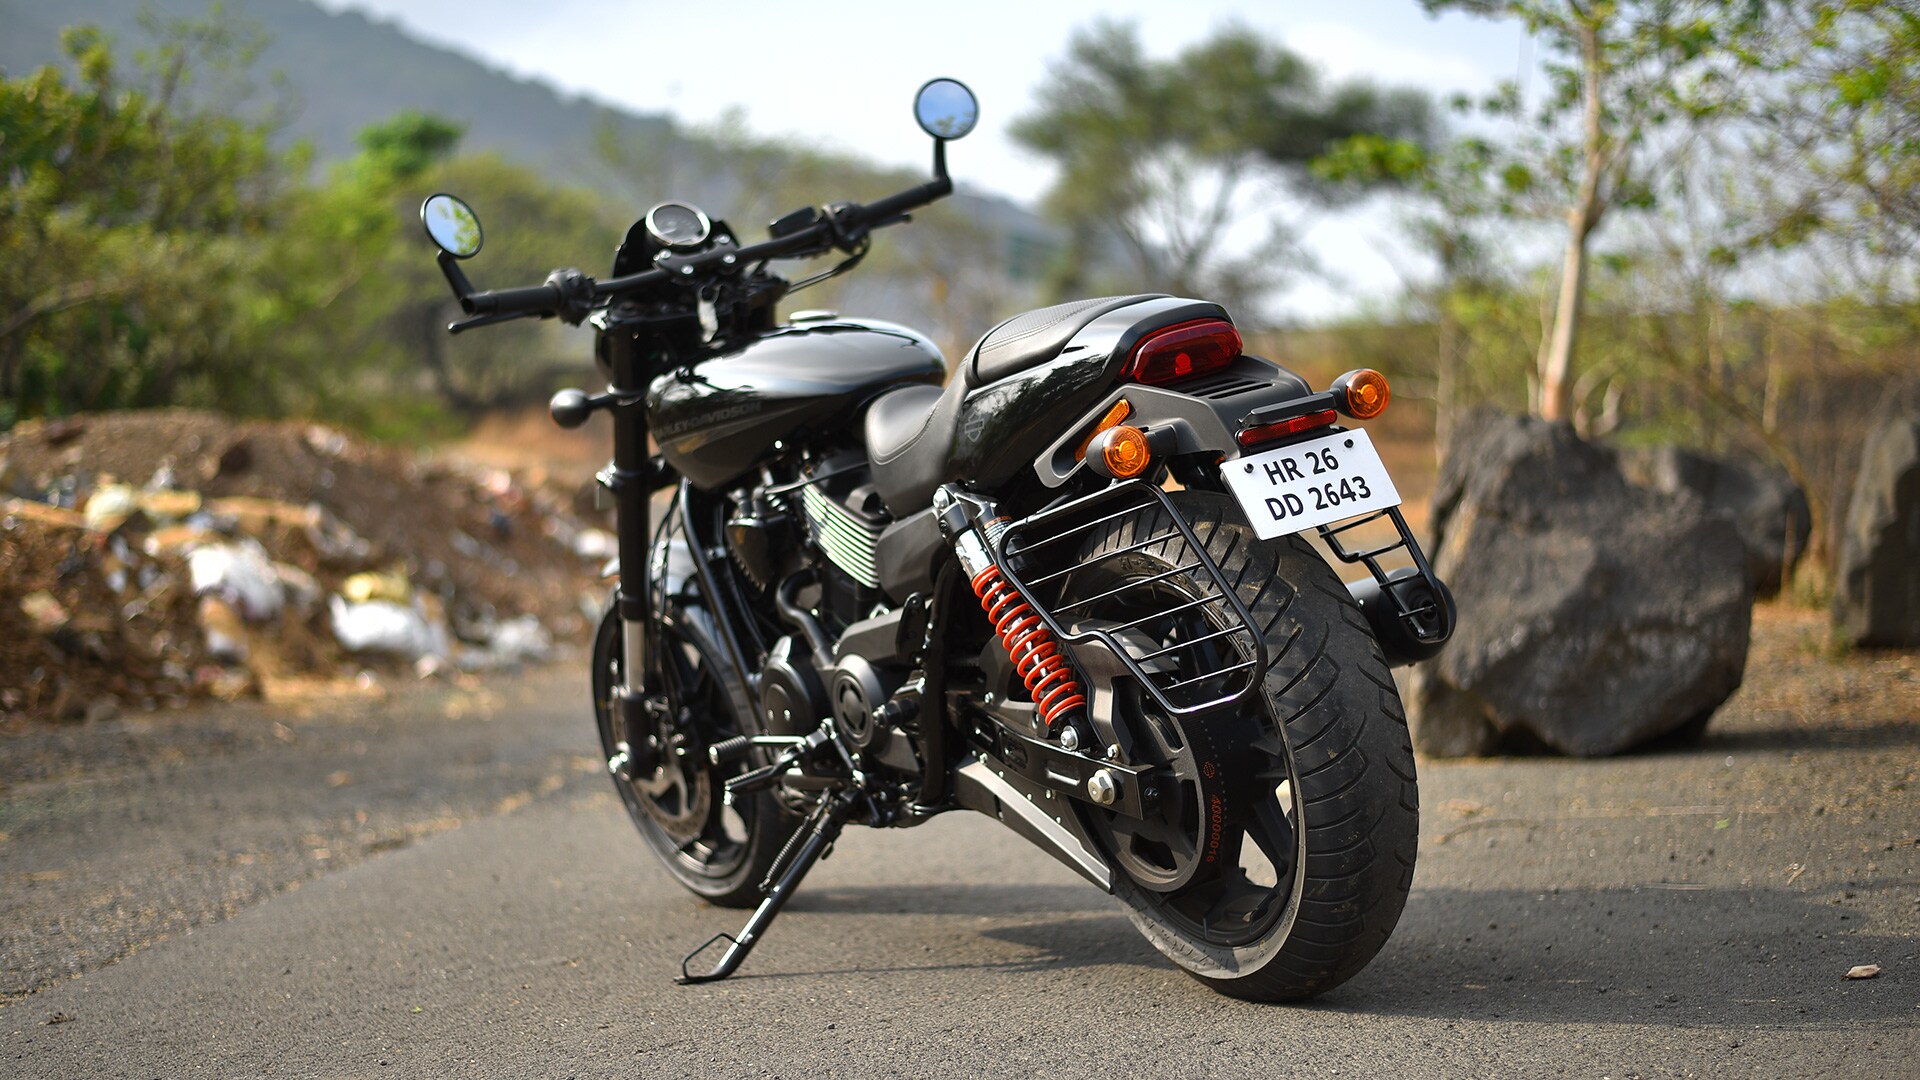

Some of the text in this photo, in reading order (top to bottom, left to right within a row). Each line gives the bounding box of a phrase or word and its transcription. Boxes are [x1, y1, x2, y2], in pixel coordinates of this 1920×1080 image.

[1263, 448, 1339, 485] HR 26
[1265, 476, 1371, 521] DD 2643
